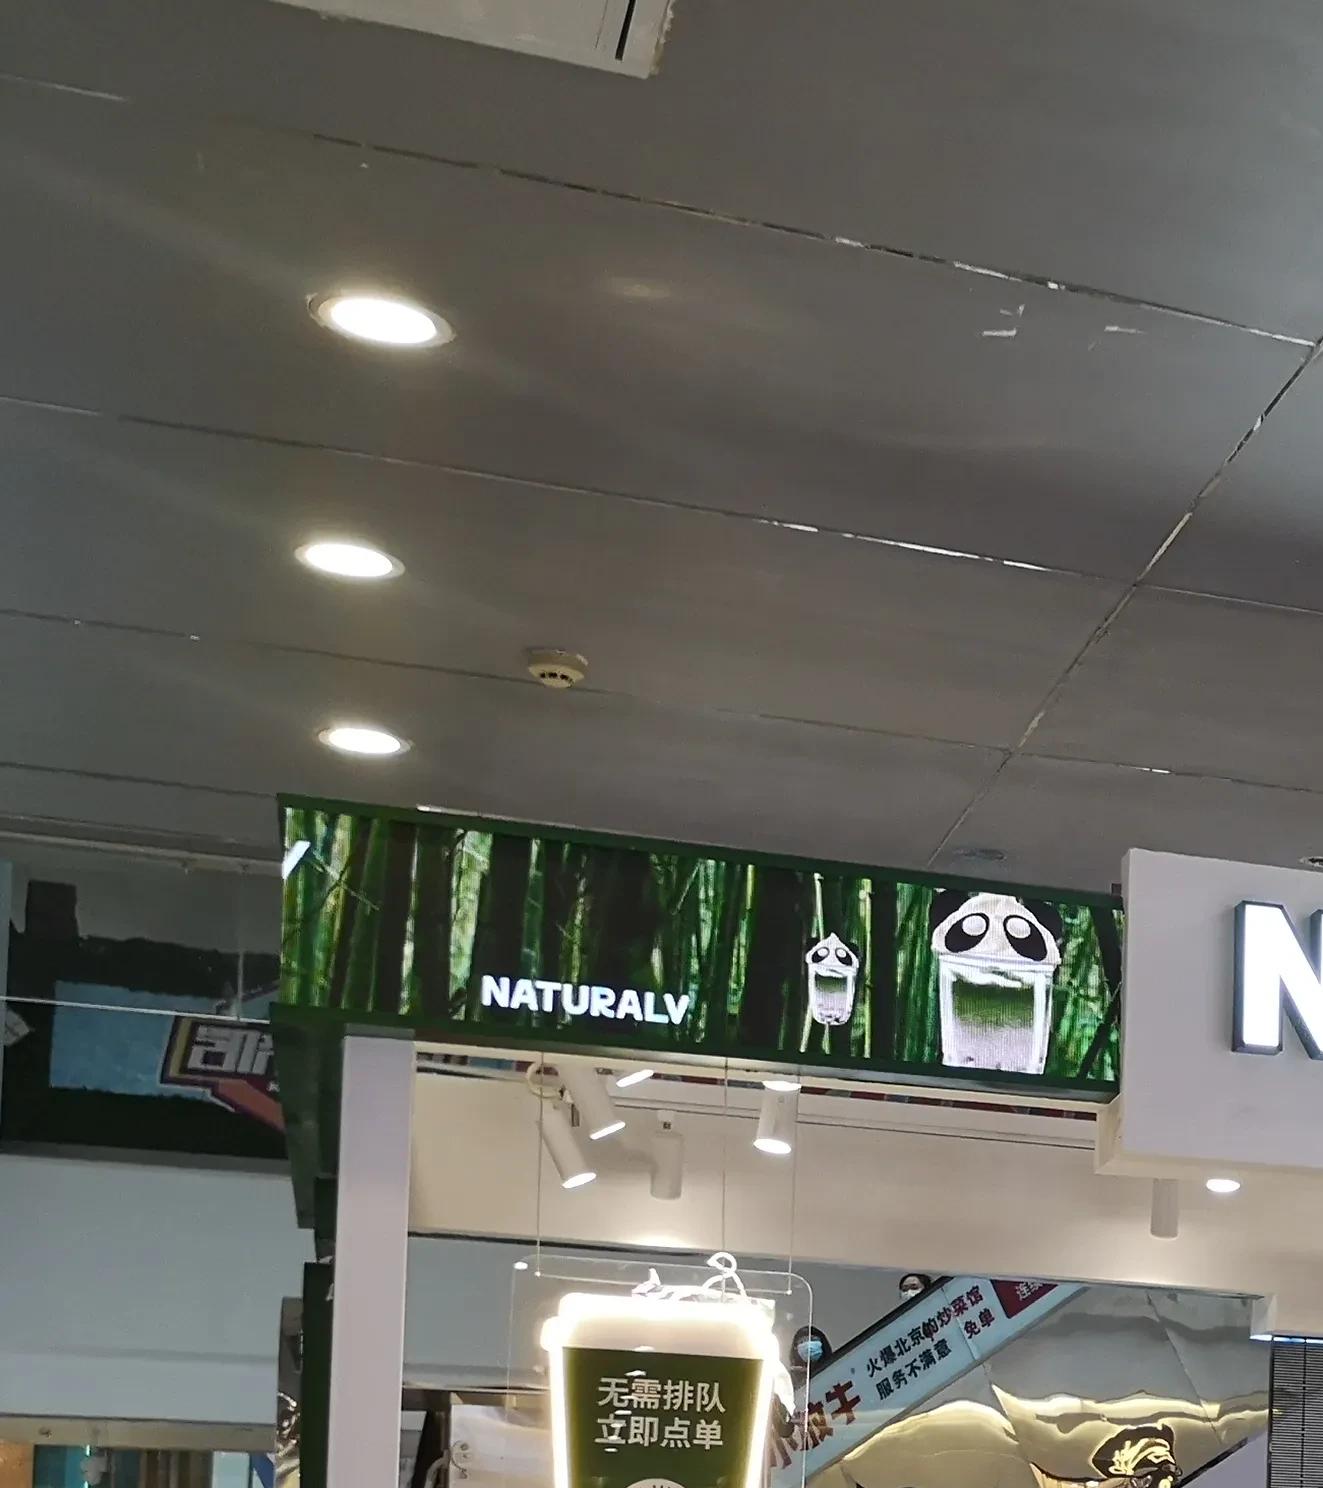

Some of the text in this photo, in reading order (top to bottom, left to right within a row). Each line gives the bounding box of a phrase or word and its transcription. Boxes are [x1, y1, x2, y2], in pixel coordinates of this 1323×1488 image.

[481, 974, 690, 1025] NATURALV
[866, 1284, 985, 1379] 火爆北京的炒菜馆
[597, 1376, 727, 1414] 无需排队
[875, 1338, 952, 1401] 服务不满意
[595, 1414, 724, 1450] 立即点单
